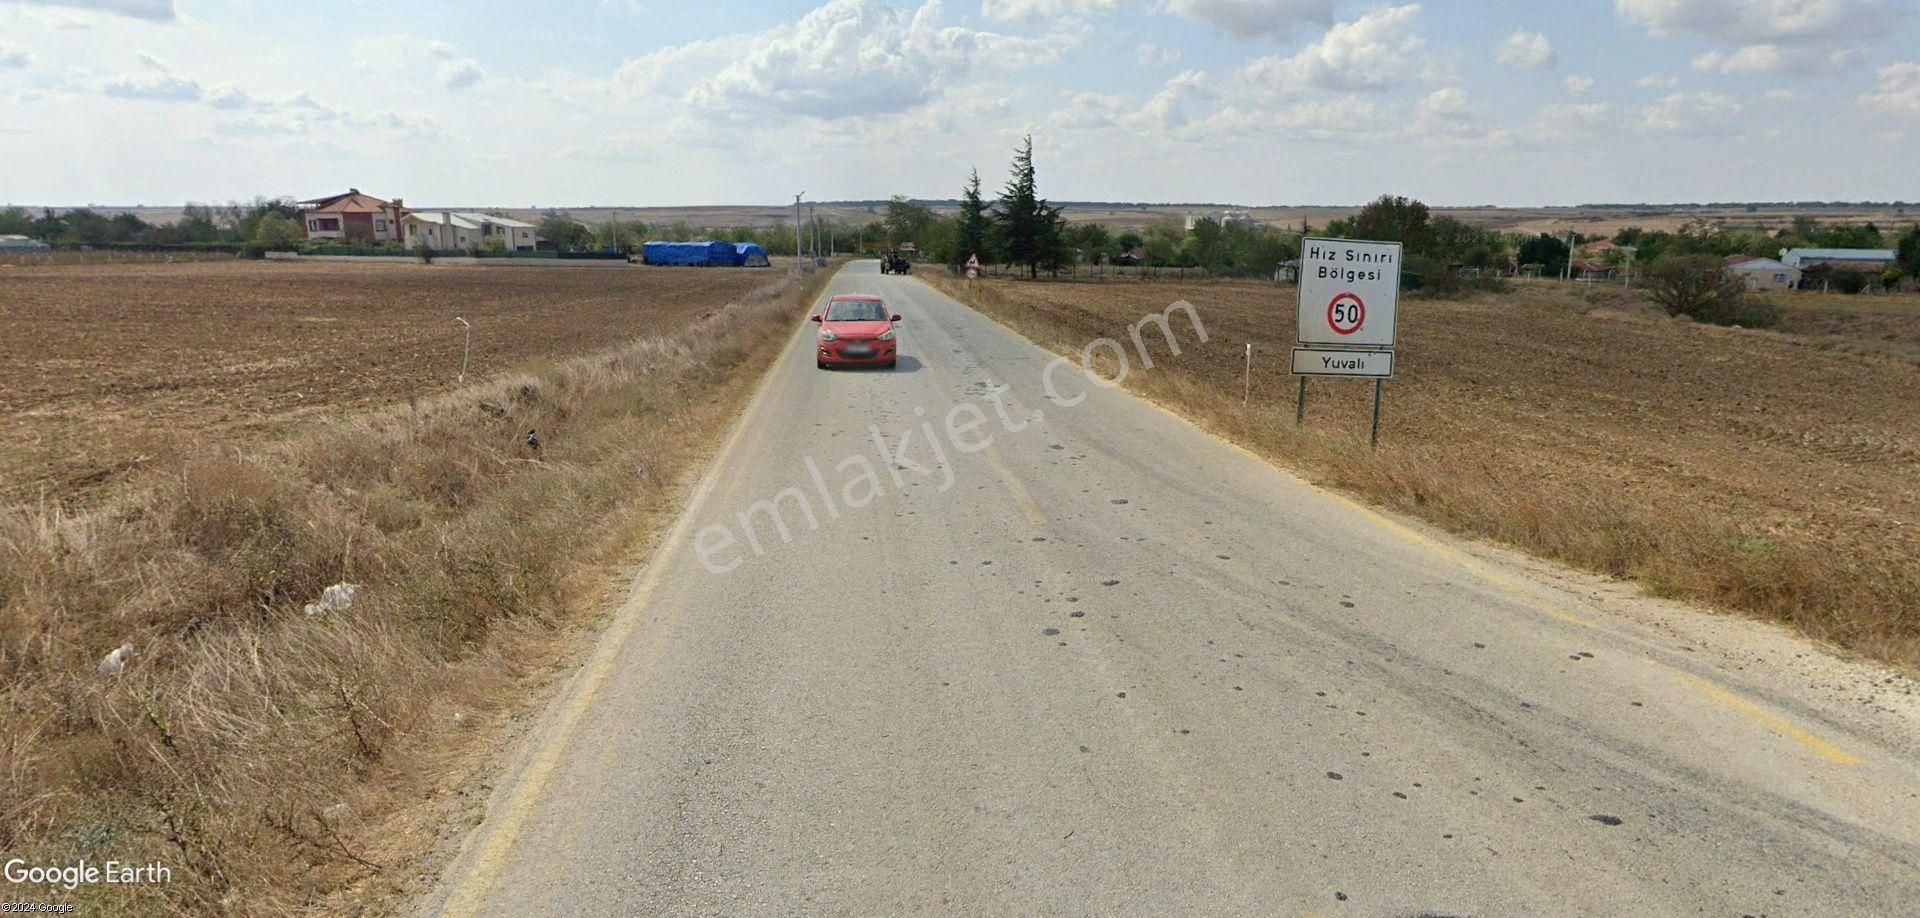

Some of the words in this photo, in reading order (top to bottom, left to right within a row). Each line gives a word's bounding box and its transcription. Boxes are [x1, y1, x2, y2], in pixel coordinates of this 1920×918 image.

[1310, 246, 1336, 261] Hız
[1345, 249, 1392, 263] Sınırı
[1318, 266, 1381, 282] Bölgesi
[1334, 304, 1358, 323] 50
[1322, 356, 1364, 370] Yuvalı
